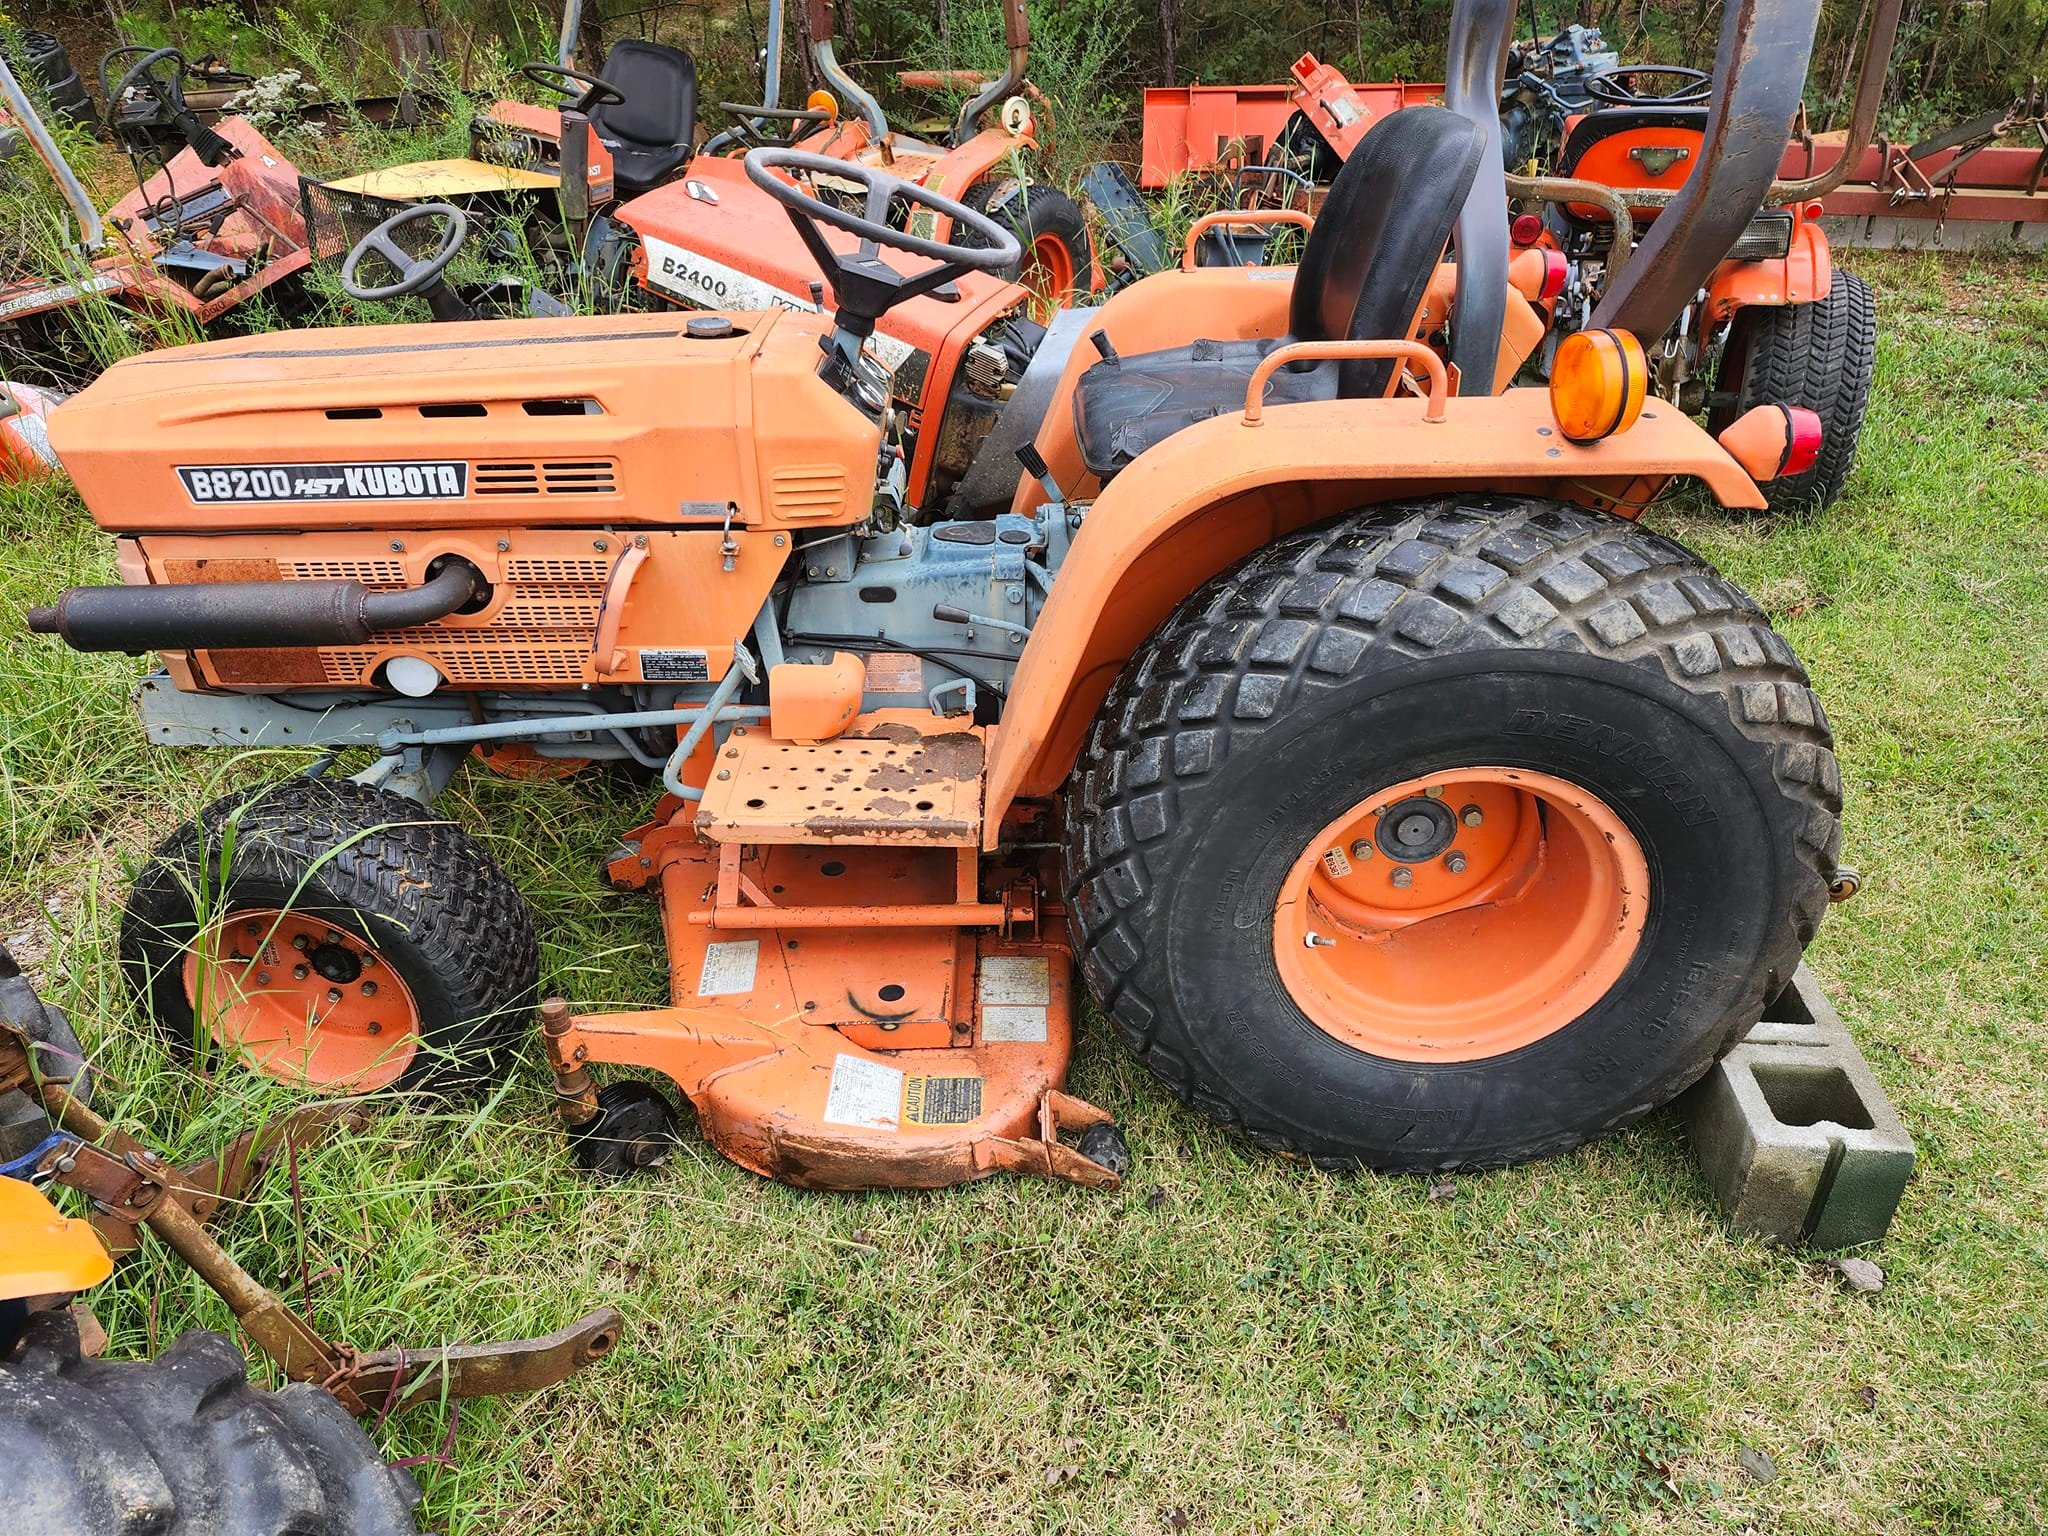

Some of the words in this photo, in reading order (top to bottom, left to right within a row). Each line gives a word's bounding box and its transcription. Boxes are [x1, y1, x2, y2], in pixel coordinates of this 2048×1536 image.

[662, 256, 727, 297] B2400
[189, 469, 291, 500] B8200
[294, 477, 345, 495] HST
[344, 466, 461, 497] KUBOTA
[1501, 708, 1719, 827] DENMAN
[1225, 1008, 1304, 1088] TRACTOR
[906, 1077, 922, 1112] CAUTION
